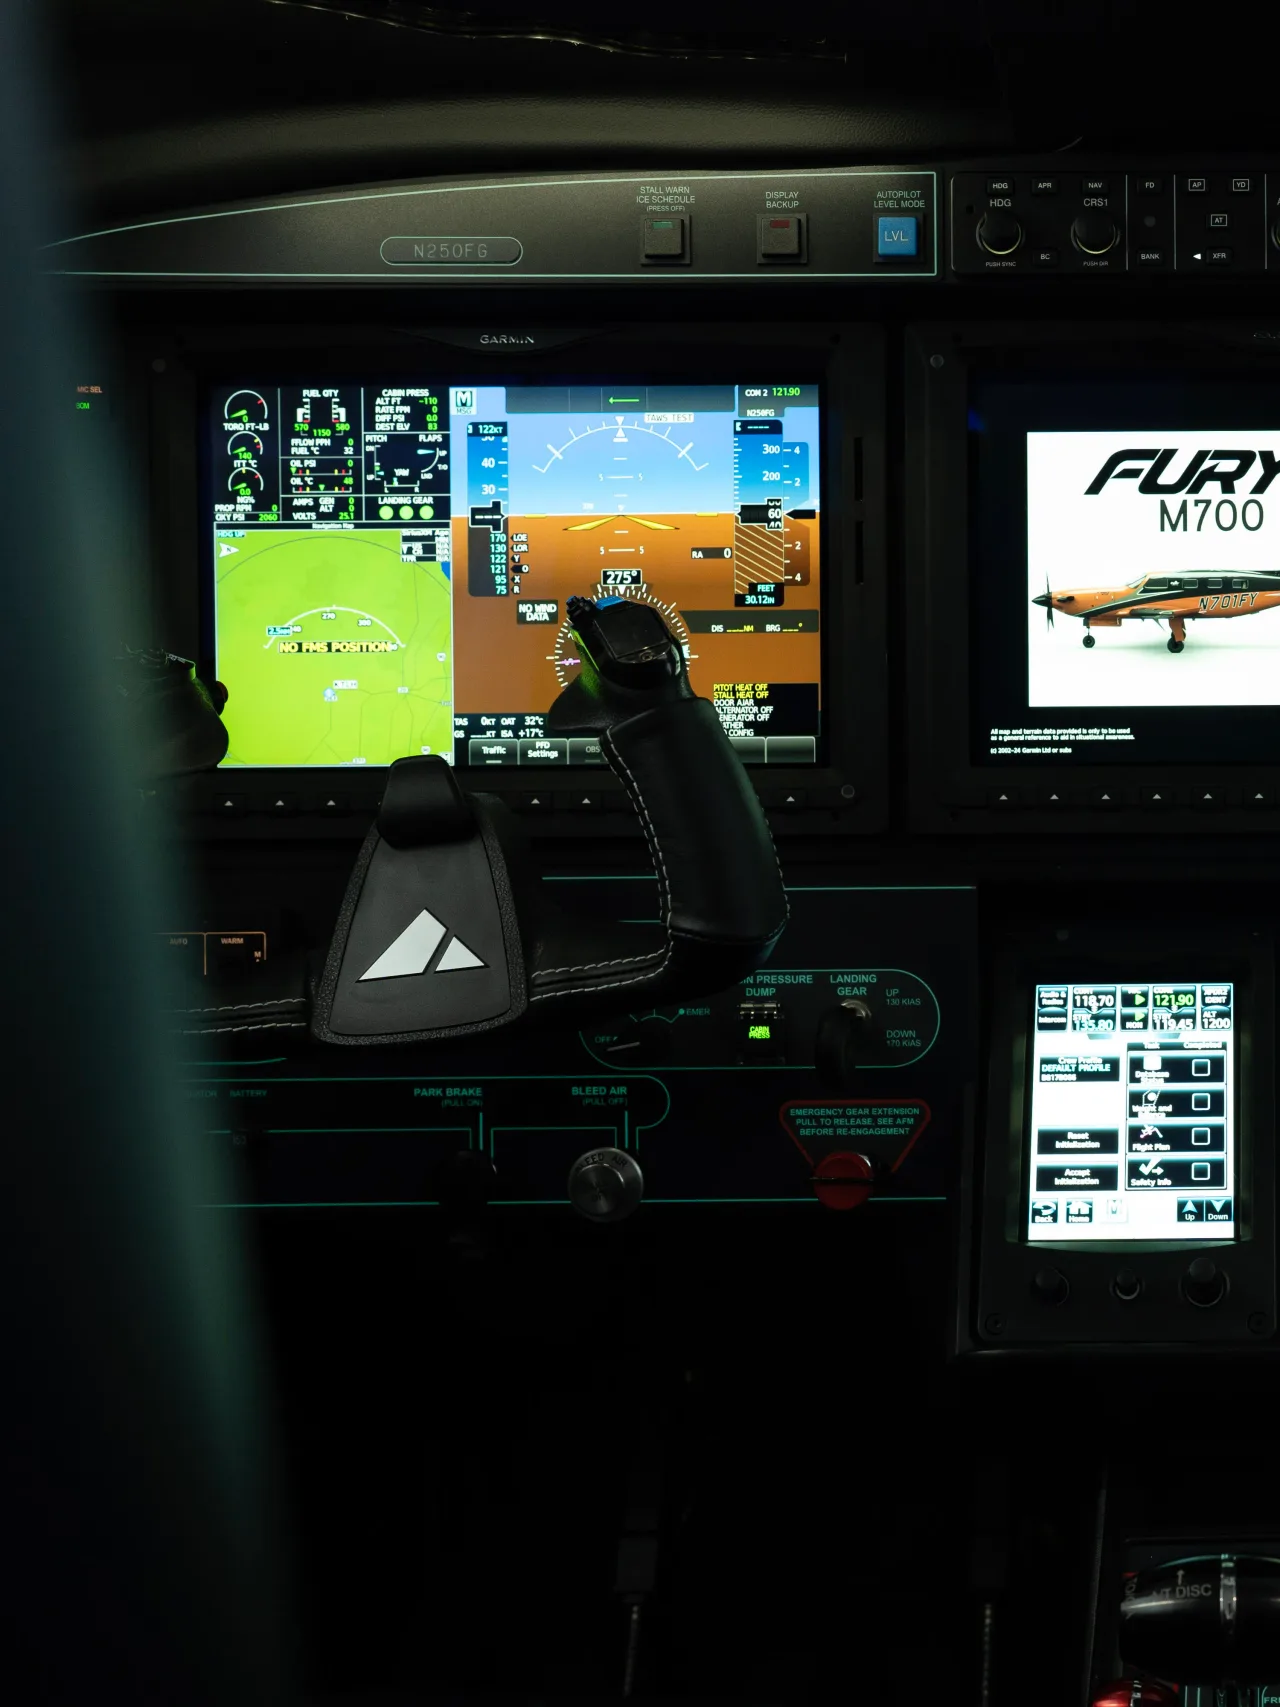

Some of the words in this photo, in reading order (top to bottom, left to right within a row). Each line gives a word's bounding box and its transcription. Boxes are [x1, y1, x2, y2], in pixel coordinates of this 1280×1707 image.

[640, 186, 664, 194] STALL
[665, 186, 690, 194] WARN
[636, 195, 649, 204] ICE
[652, 195, 695, 204] SCHEDULE
[874, 200, 899, 208] LEVEL
[901, 200, 925, 208] MODE
[990, 199, 1012, 207] HDG
[1083, 198, 1108, 207] CRS1
[884, 230, 908, 241] LVL
[414, 244, 488, 258] N250FG
[480, 334, 535, 344] GARMIN
[382, 389, 406, 397] CABIN
[406, 389, 429, 397] PRESS
[772, 388, 800, 397] 121.90
[313, 429, 331, 437] 1150
[762, 444, 780, 454] 300
[481, 458, 495, 468] 40
[762, 471, 780, 481] 200
[481, 485, 496, 495] 30
[1160, 499, 1264, 532] M700
[606, 570, 637, 584] 275°
[757, 584, 775, 592] FEET
[1199, 592, 1259, 612] N701FY
[279, 642, 298, 653] NO
[302, 642, 328, 653] FMS
[332, 642, 391, 653] POSITION
[482, 746, 506, 754] Traffic
[756, 974, 813, 984] PRESSURE
[830, 974, 877, 984] LANDING
[746, 987, 776, 997] DUMP
[837, 987, 867, 996] GEAR
[886, 989, 899, 997] UP
[1075, 995, 1114, 1007] 118.70
[1155, 994, 1194, 1006] 121.90
[1203, 1018, 1230, 1029] 1200
[748, 1026, 769, 1034] CABIN
[886, 1030, 916, 1038] DOWN
[414, 1088, 443, 1097] PARK
[445, 1088, 483, 1097] BRAKE
[571, 1086, 607, 1096] BLEED
[609, 1086, 628, 1096] AIR
[790, 1108, 844, 1116] EMERGENCY
[846, 1108, 869, 1116] GEAR
[871, 1108, 919, 1116] EXTENSION
[796, 1118, 818, 1126] PULL
[820, 1118, 832, 1126] TO
[877, 1118, 893, 1126] SEE
[895, 1118, 914, 1126] AFM
[800, 1128, 832, 1136] BEFORE
[835, 1128, 909, 1136] RE-ENGAGEMENT
[1208, 1213, 1228, 1221] Down
[1175, 1583, 1212, 1600] DISC
